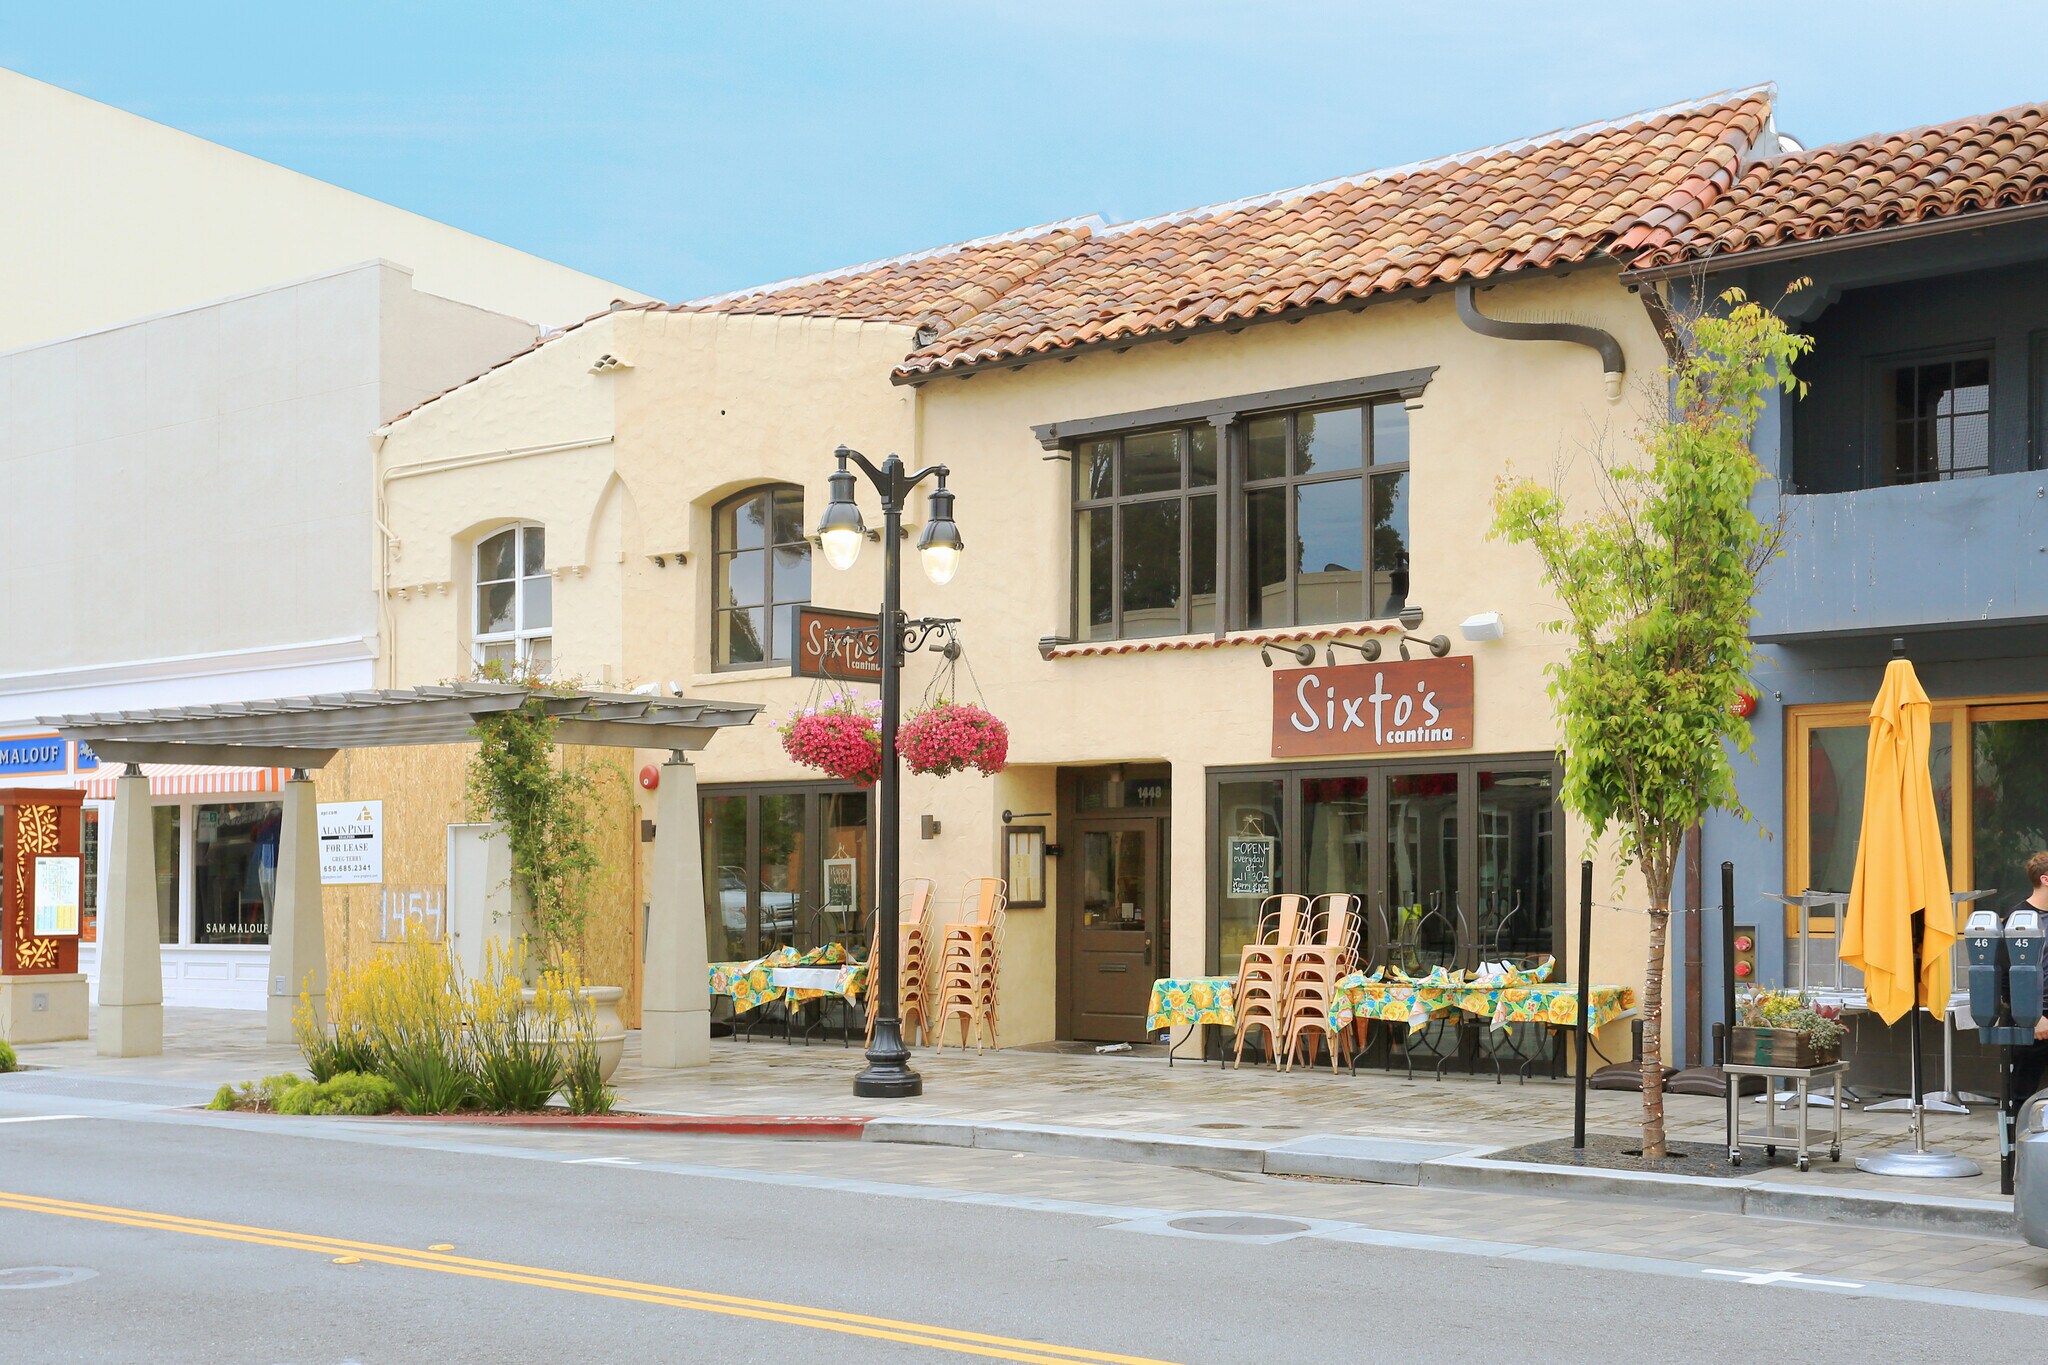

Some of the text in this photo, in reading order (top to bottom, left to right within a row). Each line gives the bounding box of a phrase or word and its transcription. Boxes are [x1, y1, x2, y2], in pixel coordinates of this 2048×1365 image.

[1290, 672, 1440, 746] Sixto's
[1386, 726, 1453, 744] cantina
[0, 746, 60, 764] MALOUF
[1138, 786, 1162, 799] 1448
[322, 825, 374, 835] ALAIN PINEL
[326, 843, 369, 852] FOR LEASE
[1240, 842, 1266, 854] OPEN
[382, 889, 441, 940] 1454
[206, 923, 269, 933] SAM MALOUF
[1974, 938, 1988, 947] 46
[2015, 938, 2029, 947] 45
